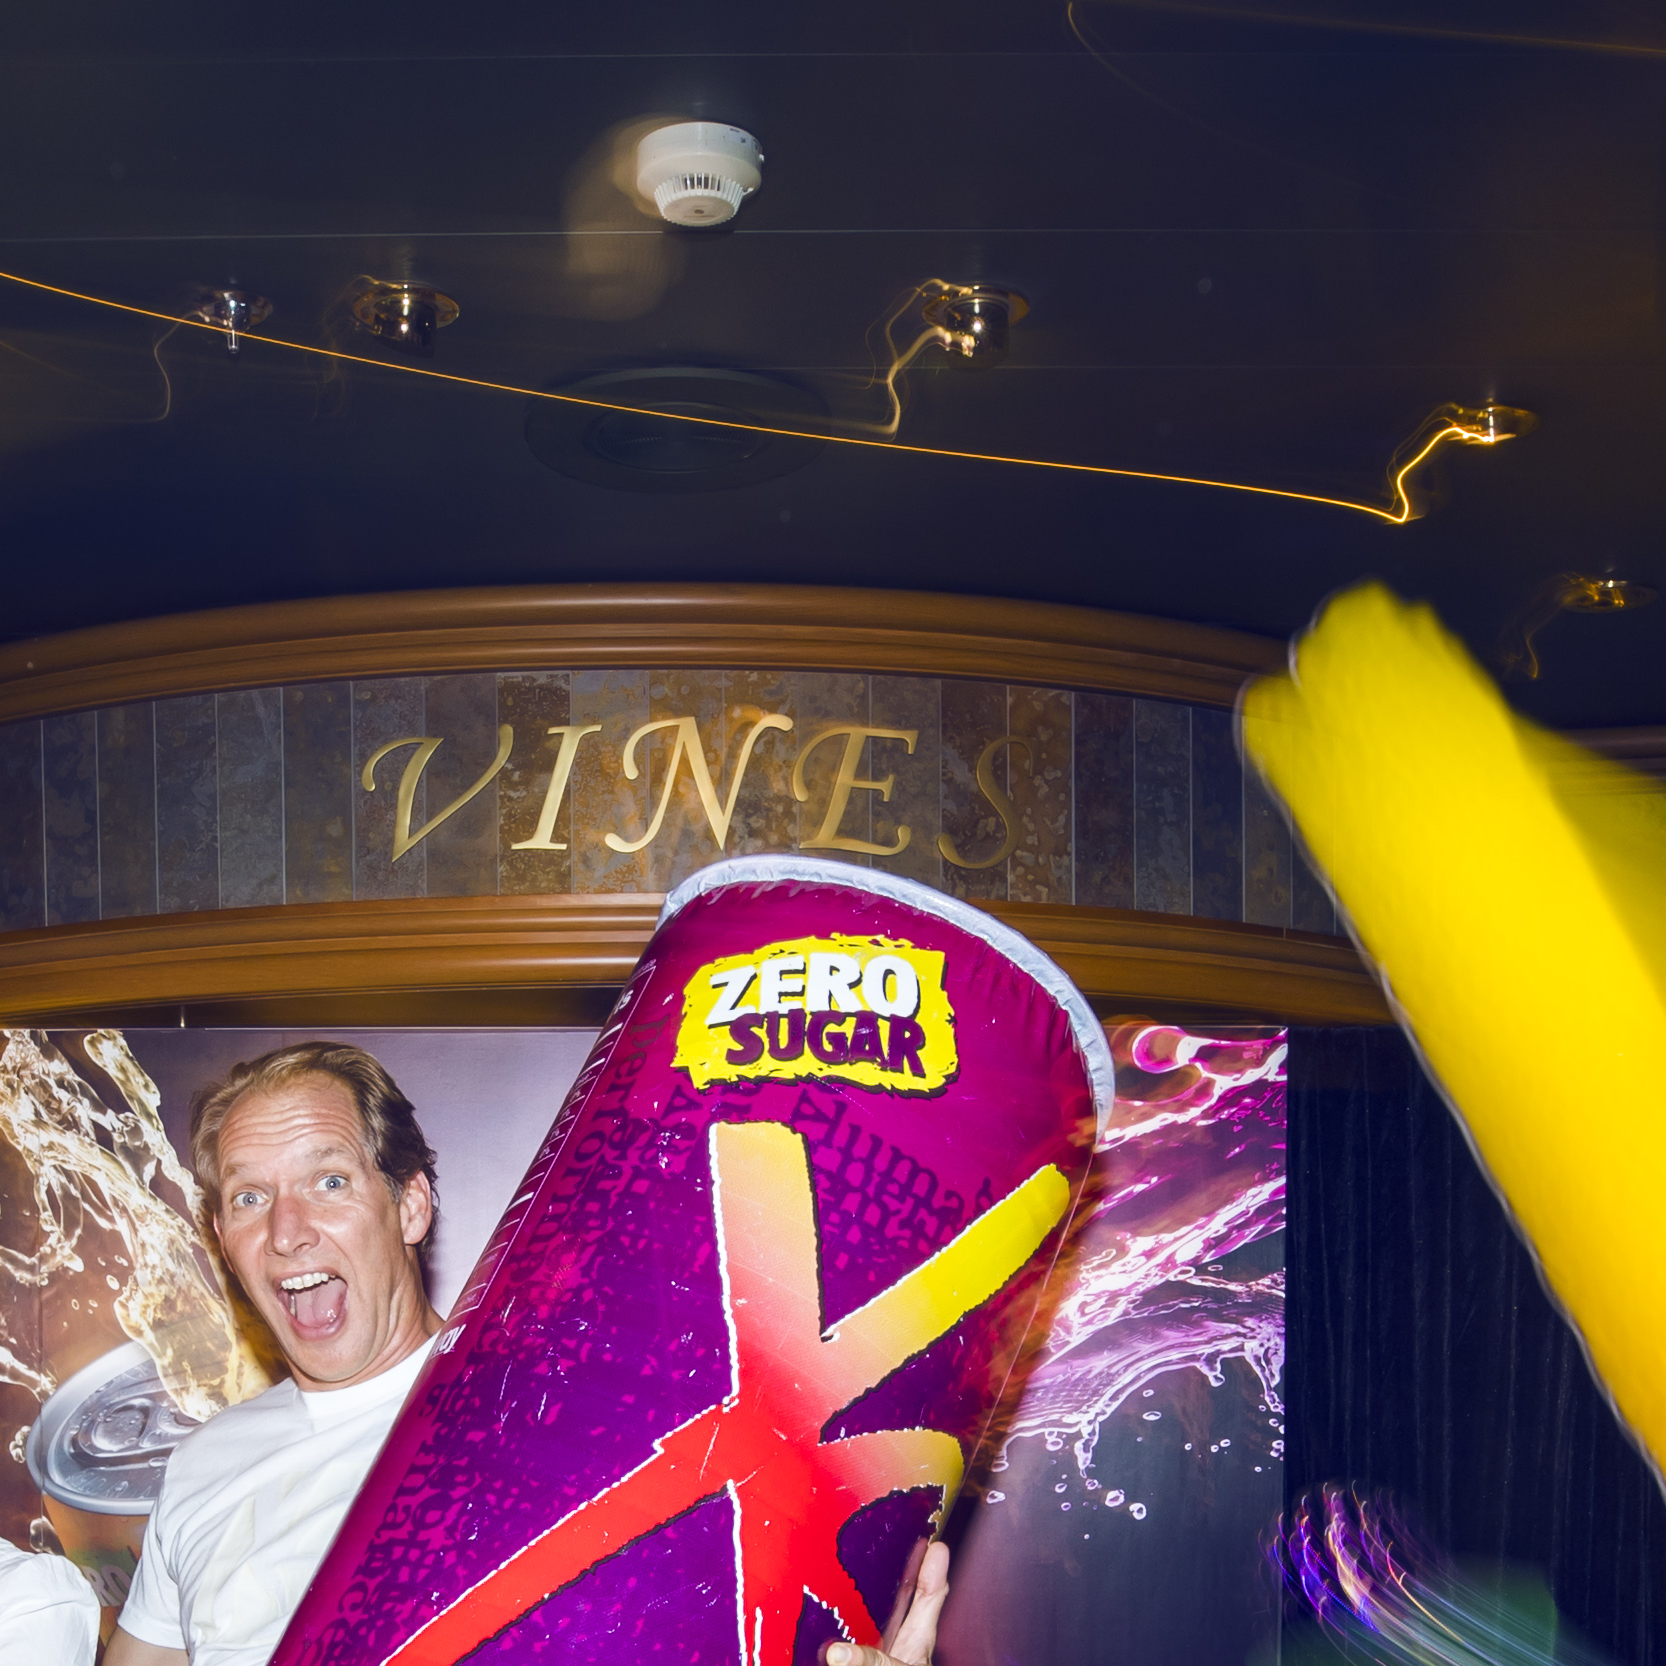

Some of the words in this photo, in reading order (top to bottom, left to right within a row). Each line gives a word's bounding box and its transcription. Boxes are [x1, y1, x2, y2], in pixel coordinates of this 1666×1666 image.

[361, 714, 1040, 869] VINES
[709, 952, 921, 1026] ZERO
[724, 1010, 926, 1078] SUGAR
